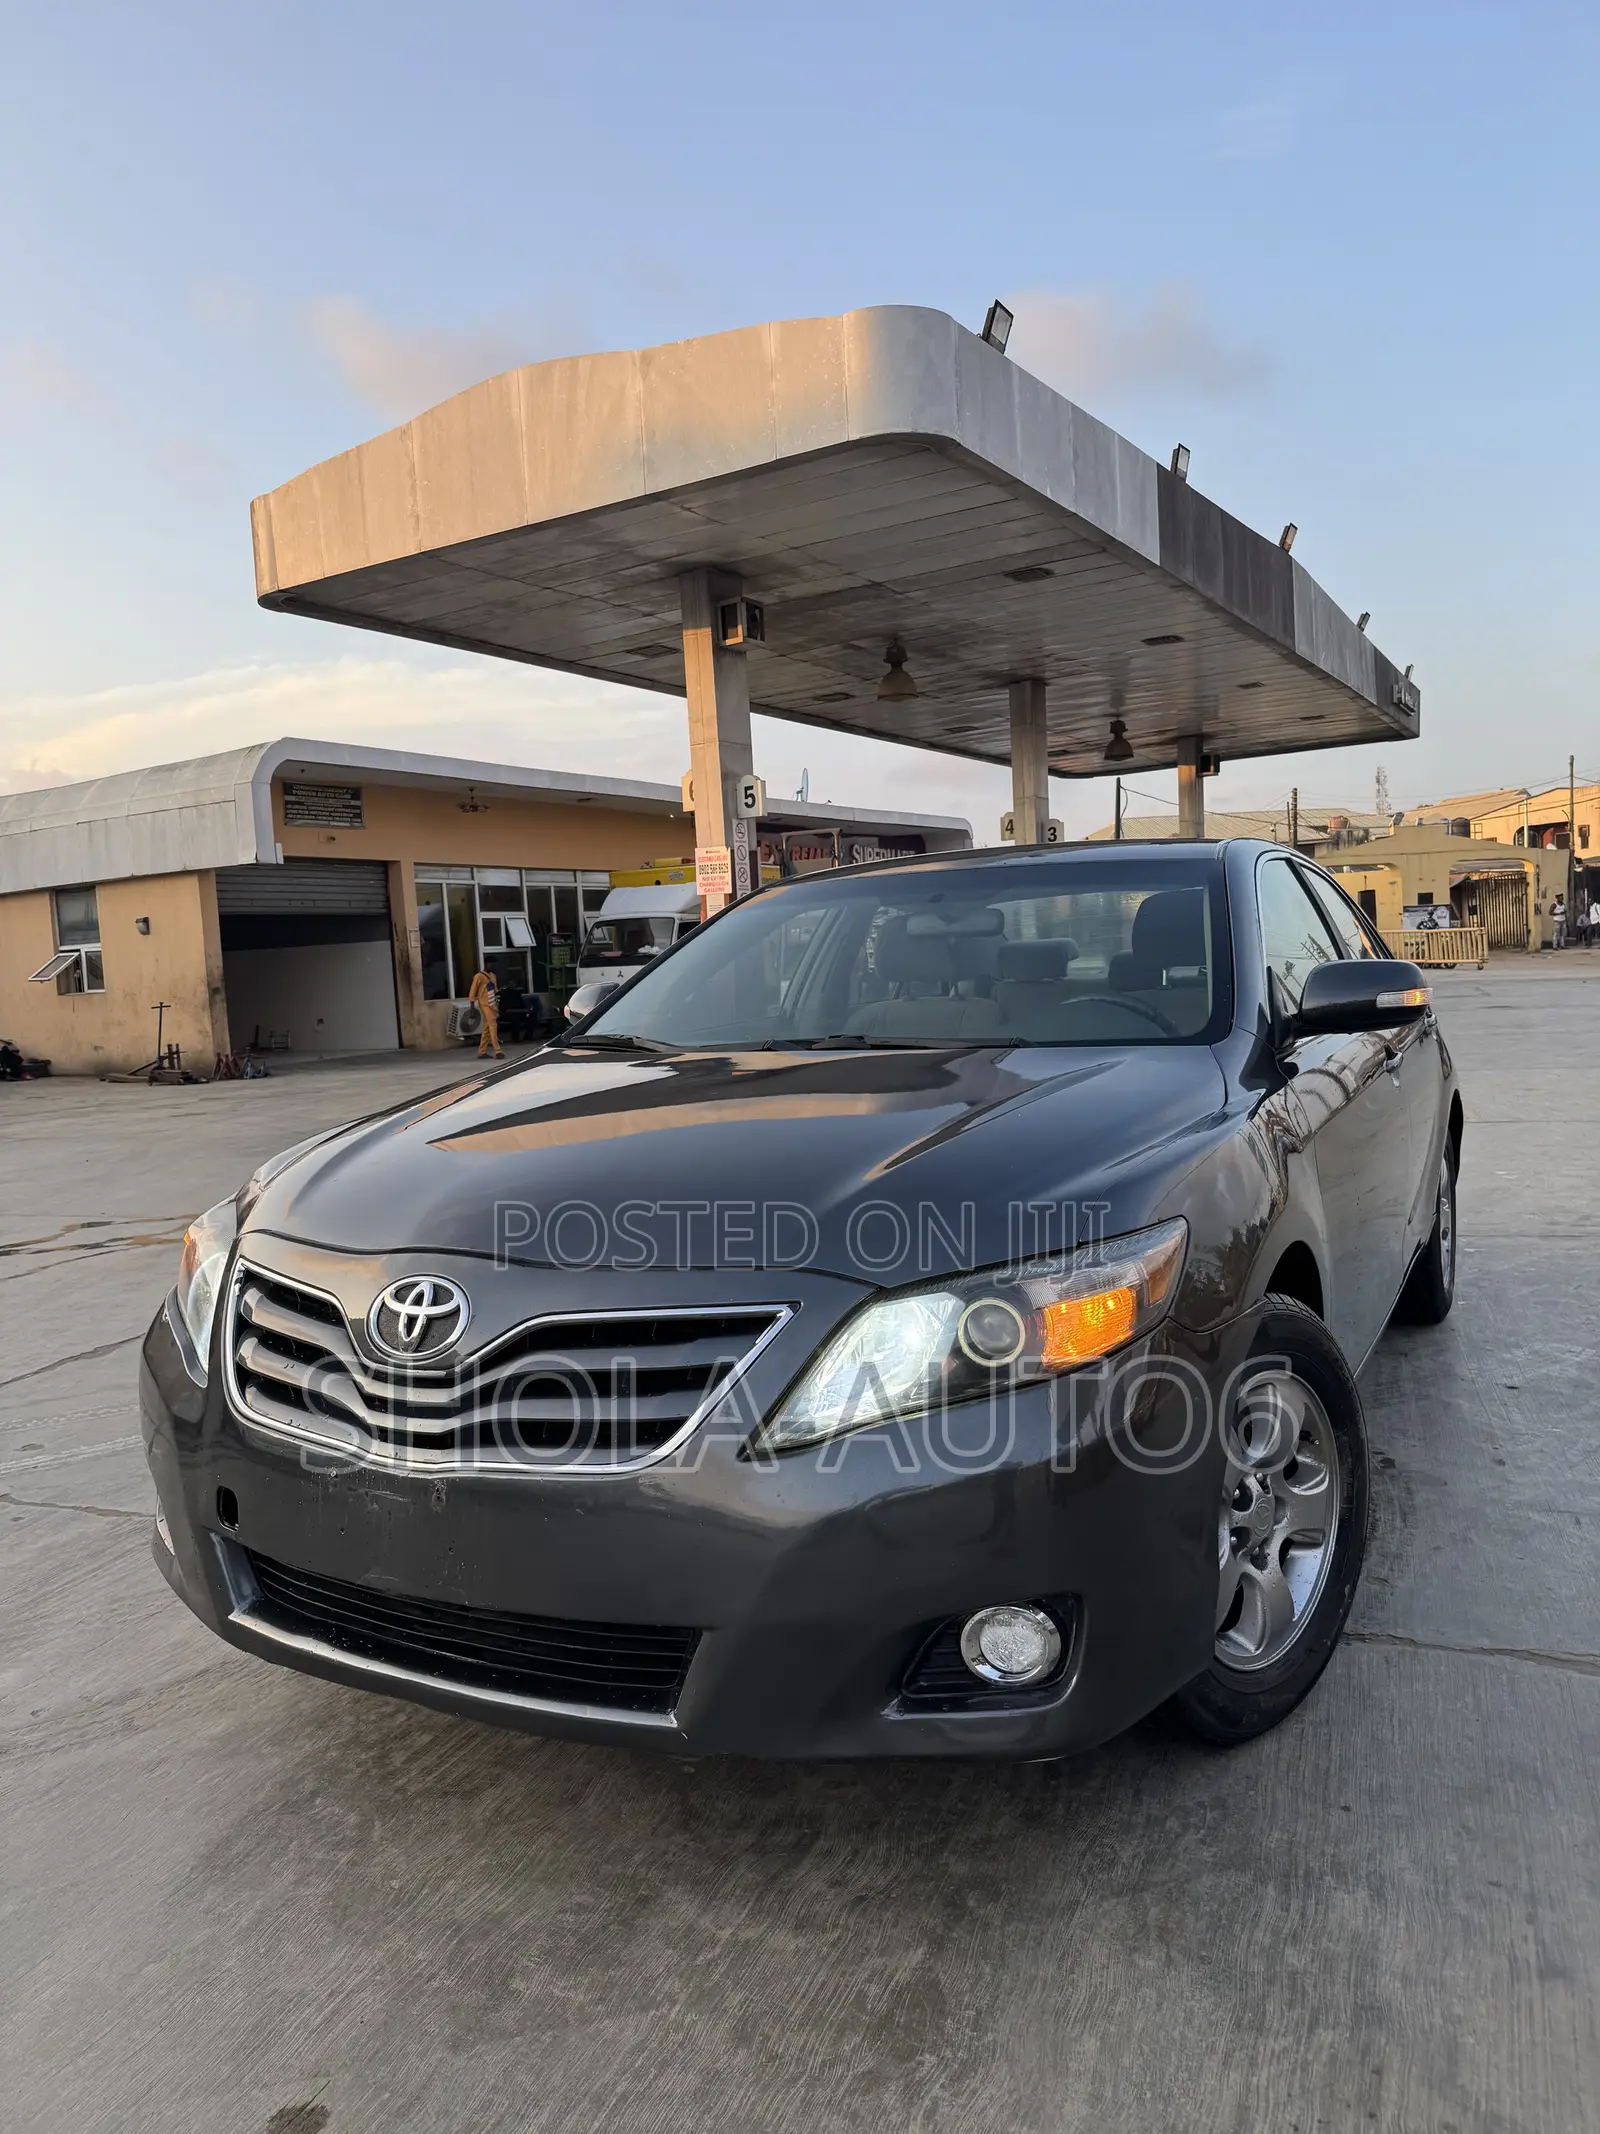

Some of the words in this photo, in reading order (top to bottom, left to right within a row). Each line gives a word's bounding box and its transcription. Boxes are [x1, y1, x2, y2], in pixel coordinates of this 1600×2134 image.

[743, 785, 756, 809] 5
[1005, 818, 1014, 834] 4
[1047, 826, 1058, 842] 3
